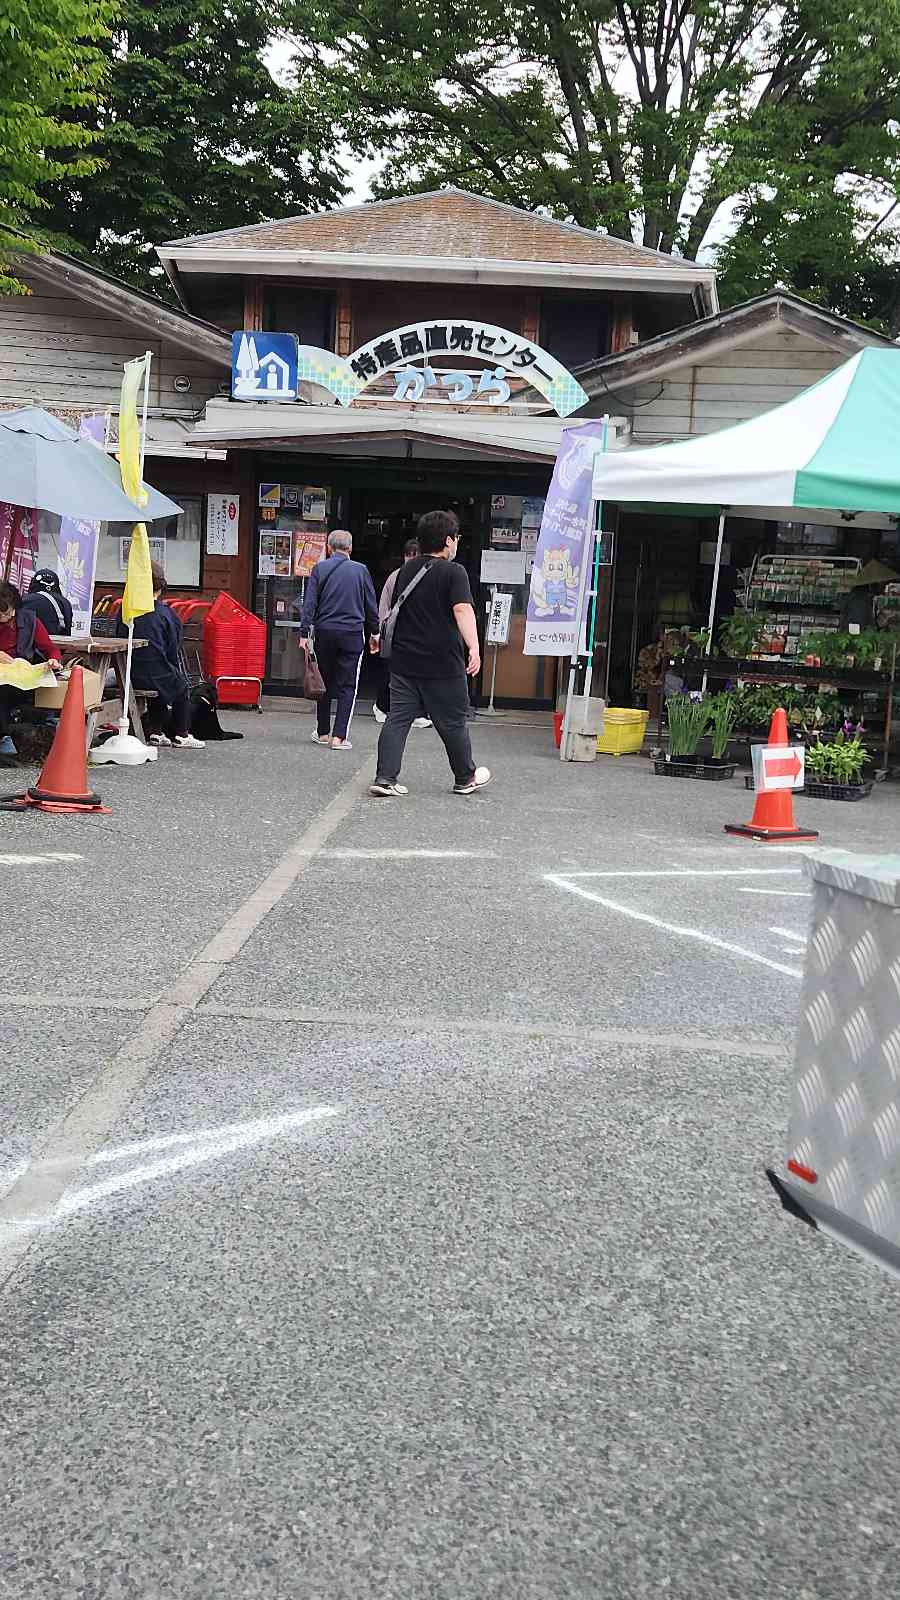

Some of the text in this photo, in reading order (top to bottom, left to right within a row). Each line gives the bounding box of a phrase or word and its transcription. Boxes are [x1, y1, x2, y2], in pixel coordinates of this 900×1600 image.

[350, 325, 555, 382] 特産品直売センター
[393, 364, 511, 405] かつら
